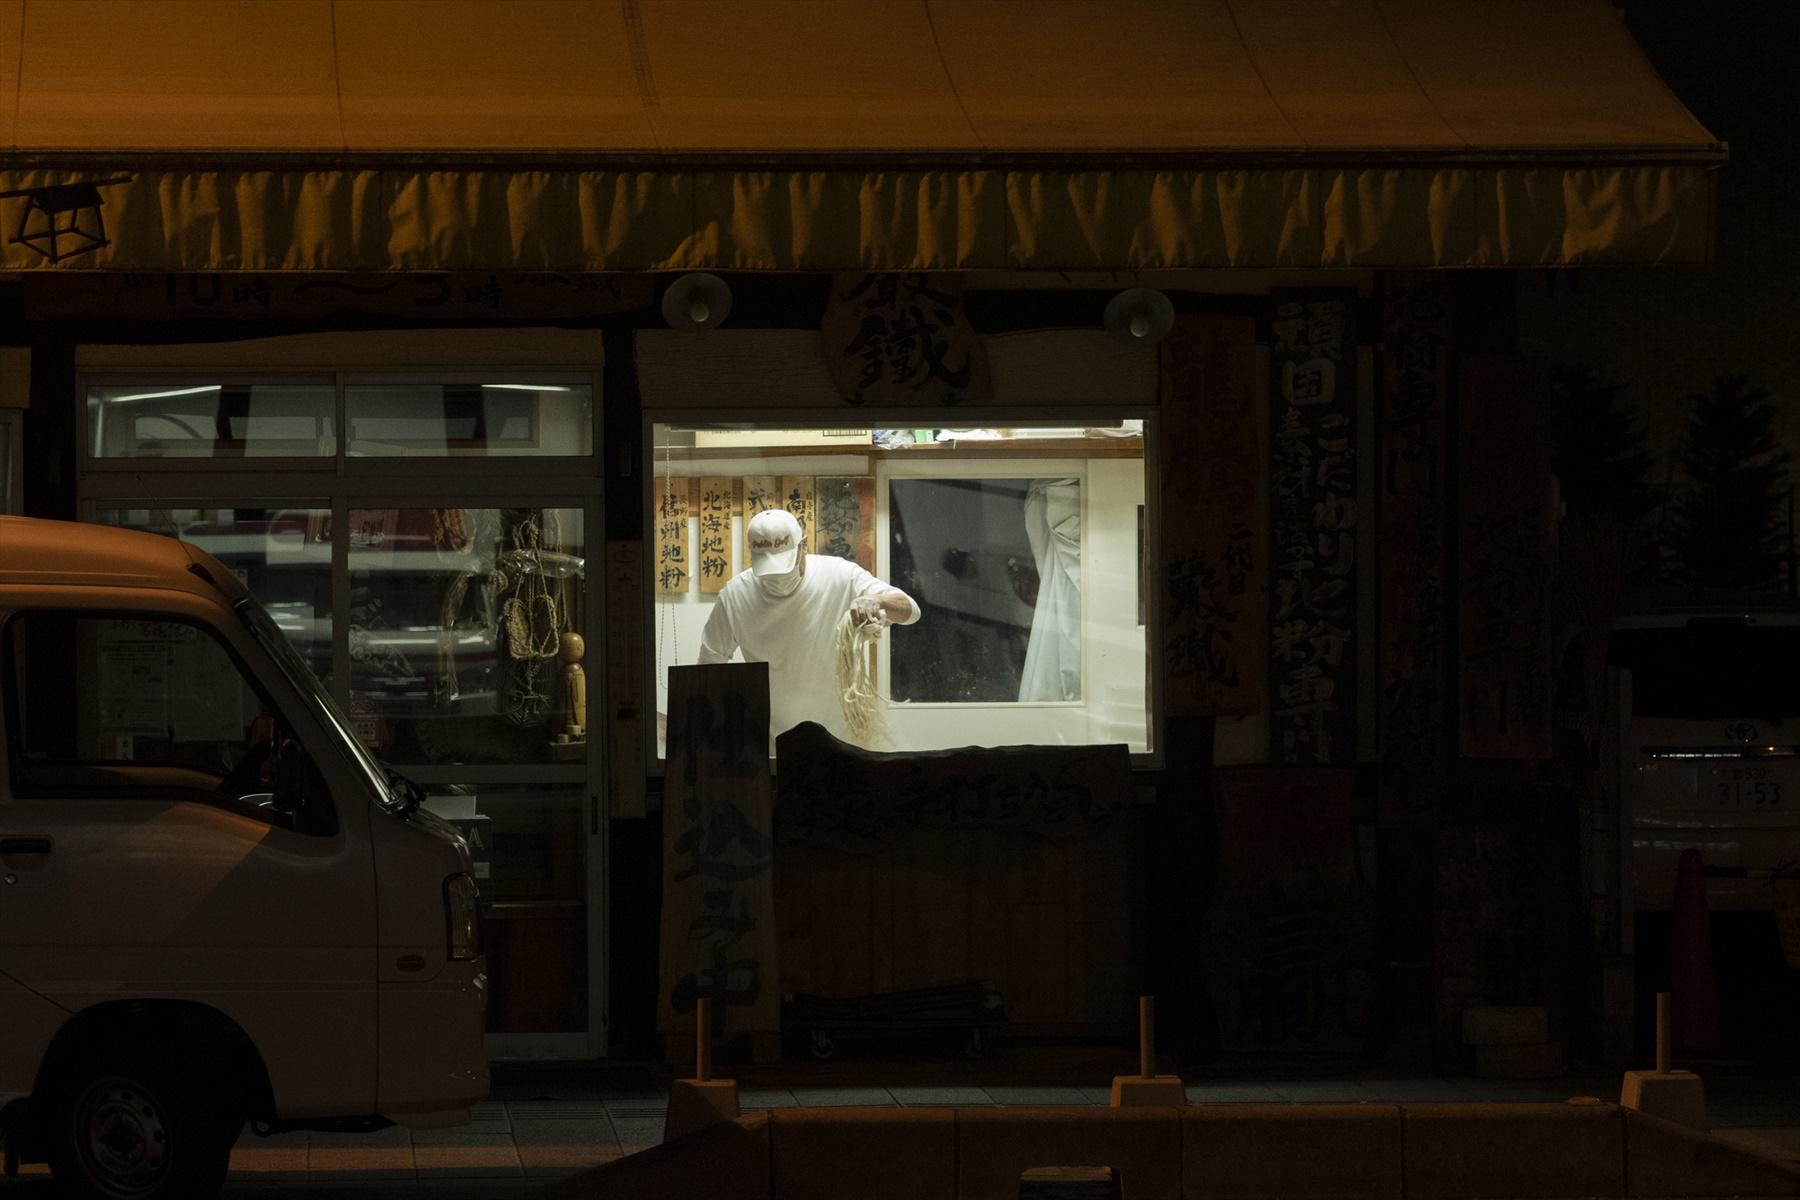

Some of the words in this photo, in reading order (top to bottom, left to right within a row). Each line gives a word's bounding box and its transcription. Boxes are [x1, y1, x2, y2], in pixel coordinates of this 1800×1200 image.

[701, 490, 728, 578] 北海地粉
[671, 691, 772, 1039] 仕込み中
